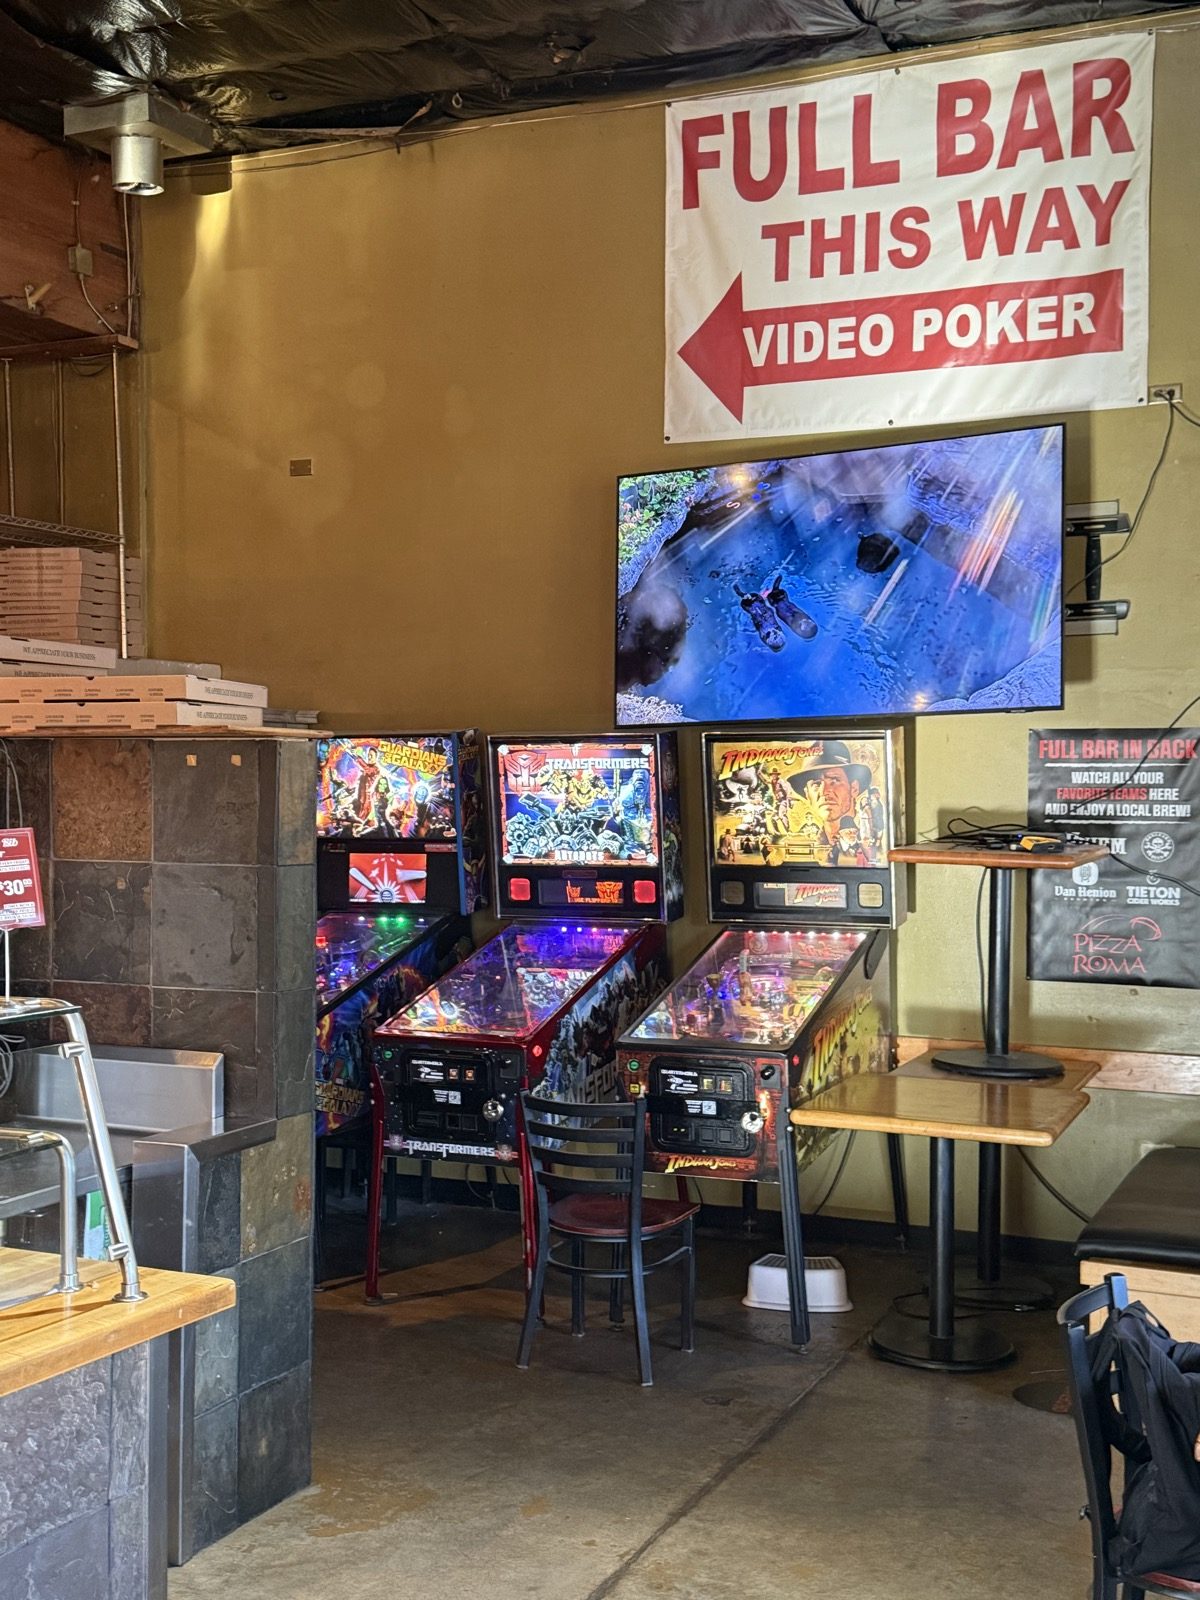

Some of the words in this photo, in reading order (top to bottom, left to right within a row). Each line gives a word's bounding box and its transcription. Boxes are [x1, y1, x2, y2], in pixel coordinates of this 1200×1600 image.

[682, 94, 899, 209] FULL
[936, 58, 1135, 177] BAR
[762, 206, 931, 282] THIS
[958, 179, 1131, 261] WAY
[742, 315, 894, 367] VIDEO
[912, 292, 1096, 351] POKER
[378, 741, 448, 765] GUARDIANS
[1039, 739, 1078, 759] FULL
[1082, 739, 1118, 759] BAR
[1123, 739, 1142, 759] IN
[1147, 738, 1197, 759] BACK
[392, 754, 444, 775] GALAXY
[546, 758, 649, 770] TRANSFORMERS
[718, 747, 789, 780] INDIANA
[784, 746, 824, 765] JONES
[1071, 771, 1112, 784] WATCH
[1112, 771, 1131, 784] ALL
[1133, 771, 1164, 784] YOUR
[1056, 787, 1109, 801] FAVORITE
[1111, 787, 1147, 801] TEAMS
[1149, 788, 1179, 801] HERE
[1045, 803, 1067, 816] AND
[1070, 803, 1104, 816] ENJOY
[1106, 804, 1114, 815] A
[1116, 804, 1151, 816] LOCAL
[1153, 804, 1191, 817] BREW!
[793, 885, 839, 904] INDIANA
[1126, 886, 1180, 899] TIETON
[1072, 933, 1143, 953] PIZZA
[1072, 954, 1146, 975] ROMA
[405, 1140, 496, 1157] TRANSFORMERS
[665, 1154, 713, 1173] INDIANA
[710, 1157, 736, 1169] JONES
